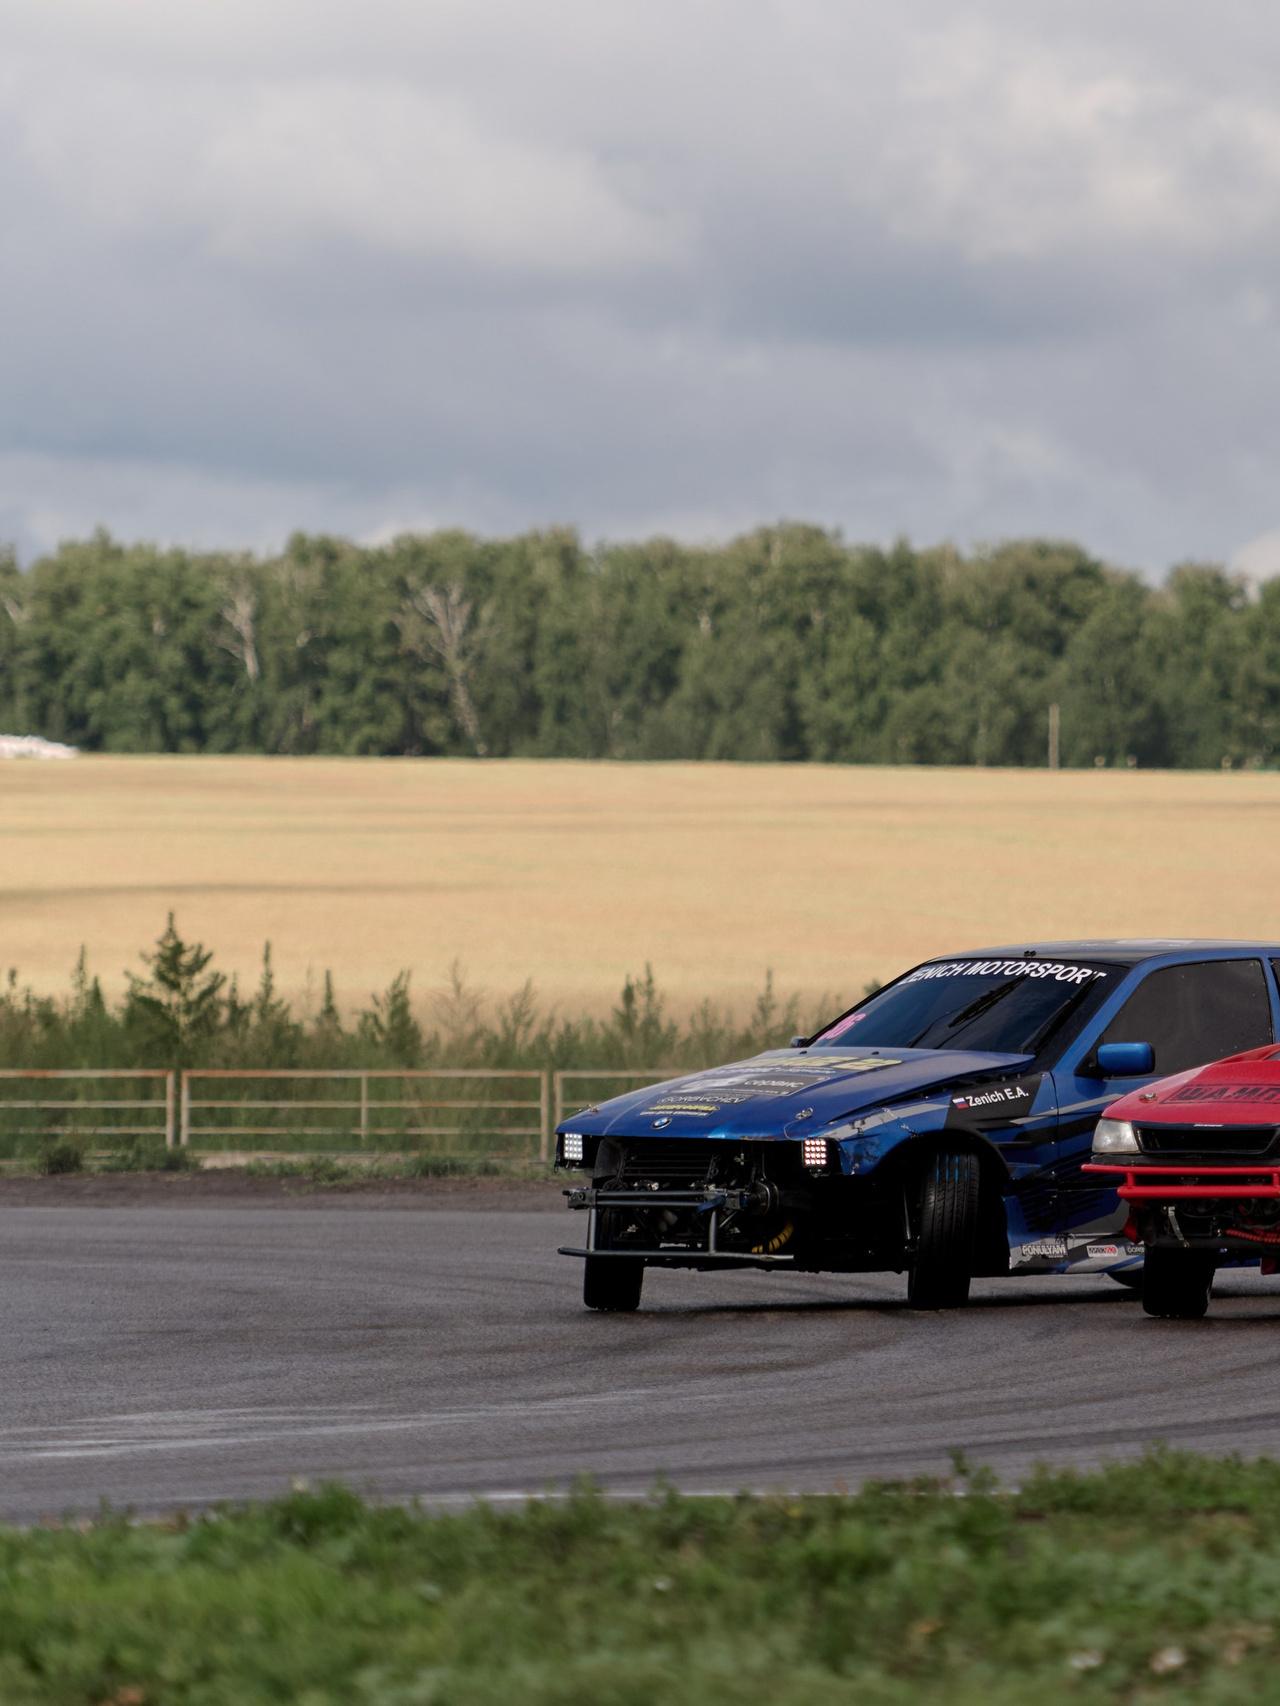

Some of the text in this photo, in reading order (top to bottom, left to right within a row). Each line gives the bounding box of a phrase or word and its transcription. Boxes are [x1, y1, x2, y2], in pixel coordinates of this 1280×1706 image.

[965, 1086, 1029, 1107] Zenich E.A.
[1022, 1243, 1067, 1256] PONULYAM
